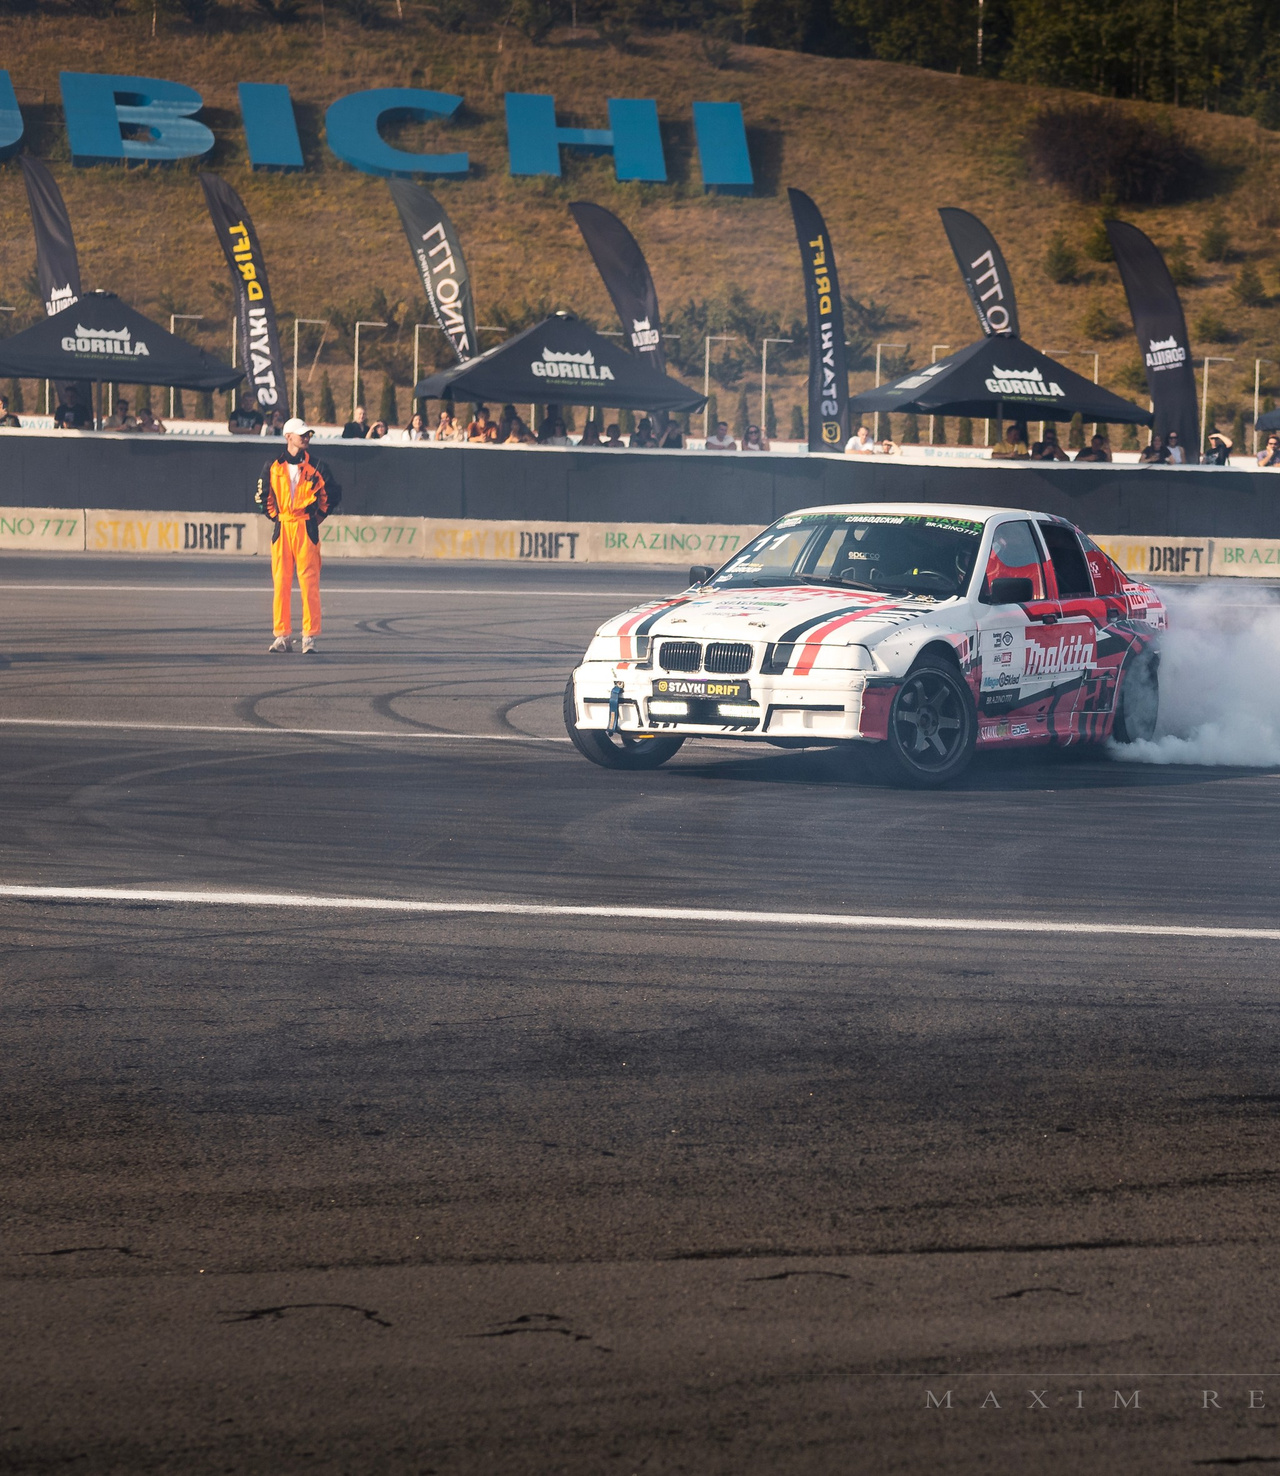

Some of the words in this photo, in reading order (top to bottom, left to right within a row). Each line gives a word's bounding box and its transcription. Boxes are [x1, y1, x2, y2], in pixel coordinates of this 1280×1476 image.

[0, 69, 754, 192] BICHI
[61, 336, 150, 356] GORILLA
[531, 361, 615, 381] GORILLA
[985, 378, 1066, 397] GORILLA
[184, 522, 247, 550] DRIFT
[519, 531, 580, 559] DRIFT
[753, 533, 791, 552] 11
[1149, 546, 1204, 573] DRIFT
[668, 682, 705, 694] STAYKI
[707, 684, 740, 696] DRIFT
